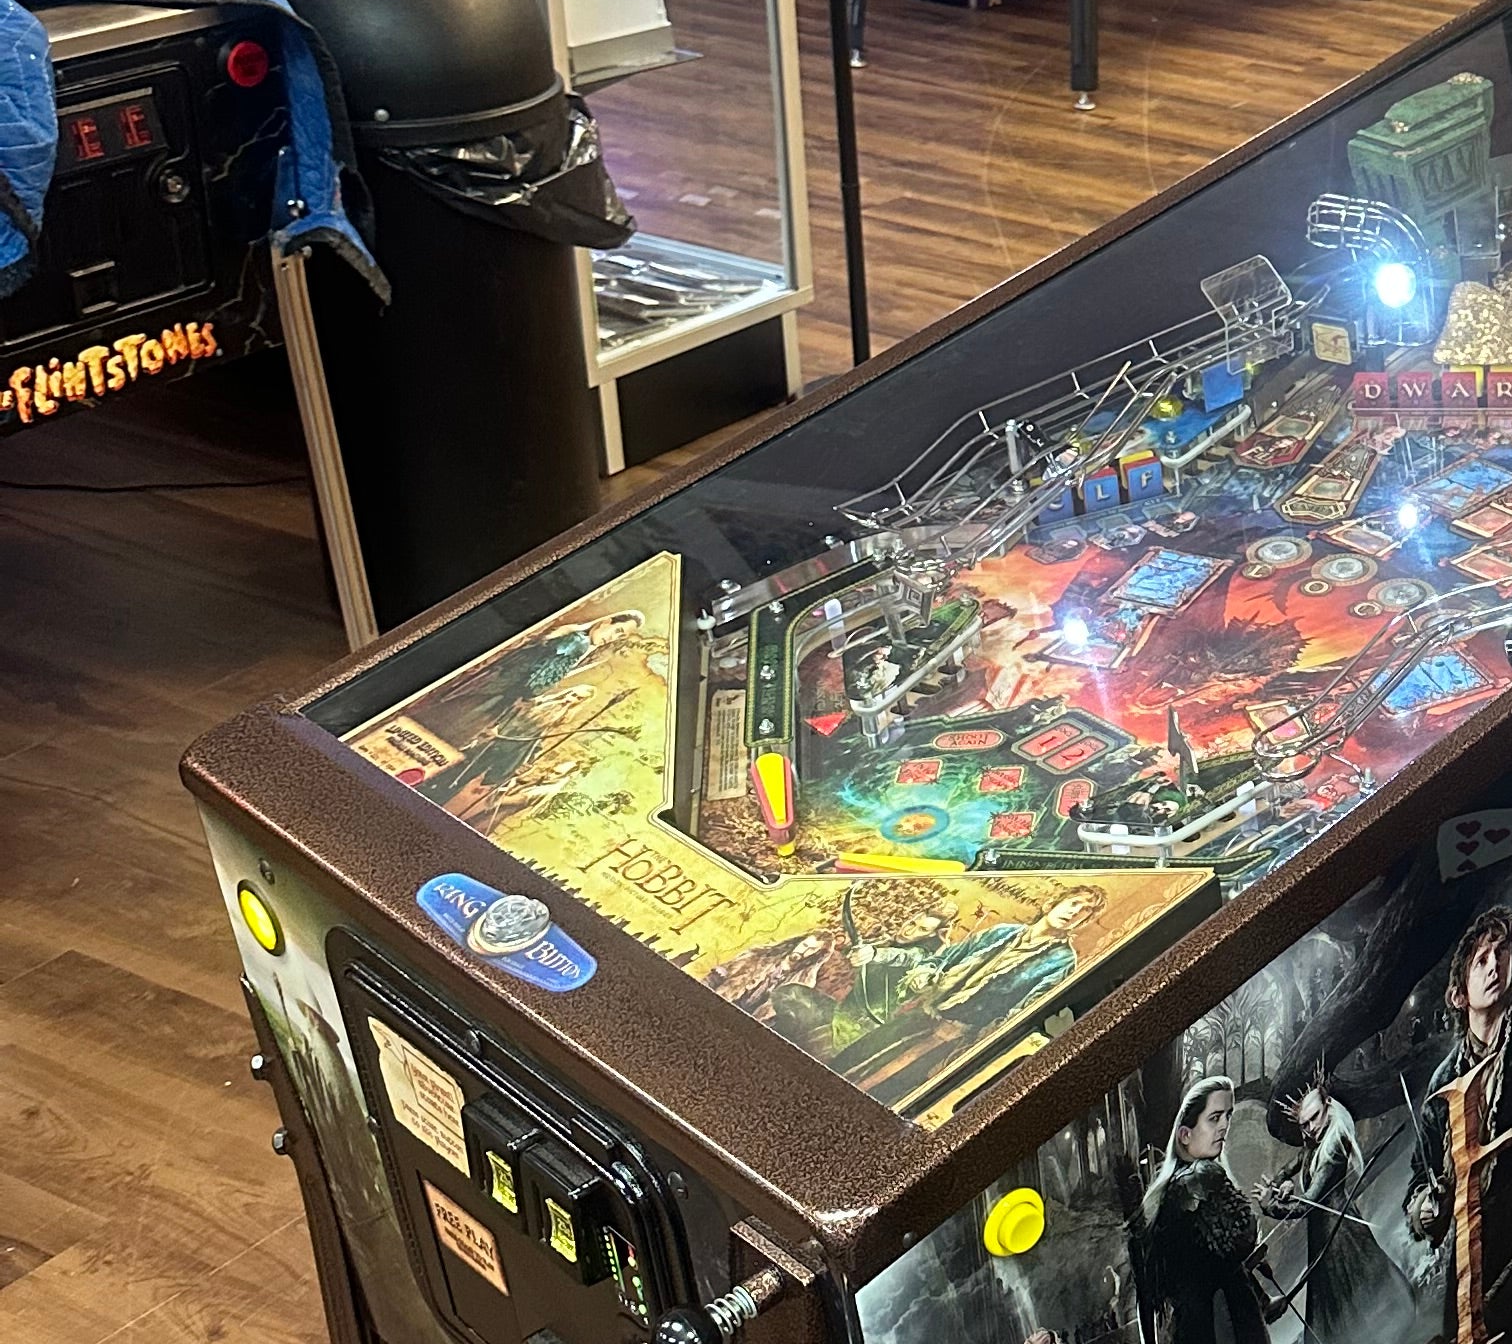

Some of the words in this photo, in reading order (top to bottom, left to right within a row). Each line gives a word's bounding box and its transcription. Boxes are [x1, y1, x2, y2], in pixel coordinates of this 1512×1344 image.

[8, 322, 218, 424] FLINTSTONES
[949, 732, 990, 742] SHOOT
[951, 738, 987, 747] AGAIN
[432, 882, 487, 919] RING
[576, 834, 741, 936] HOBBIT
[434, 1202, 464, 1236] FREE
